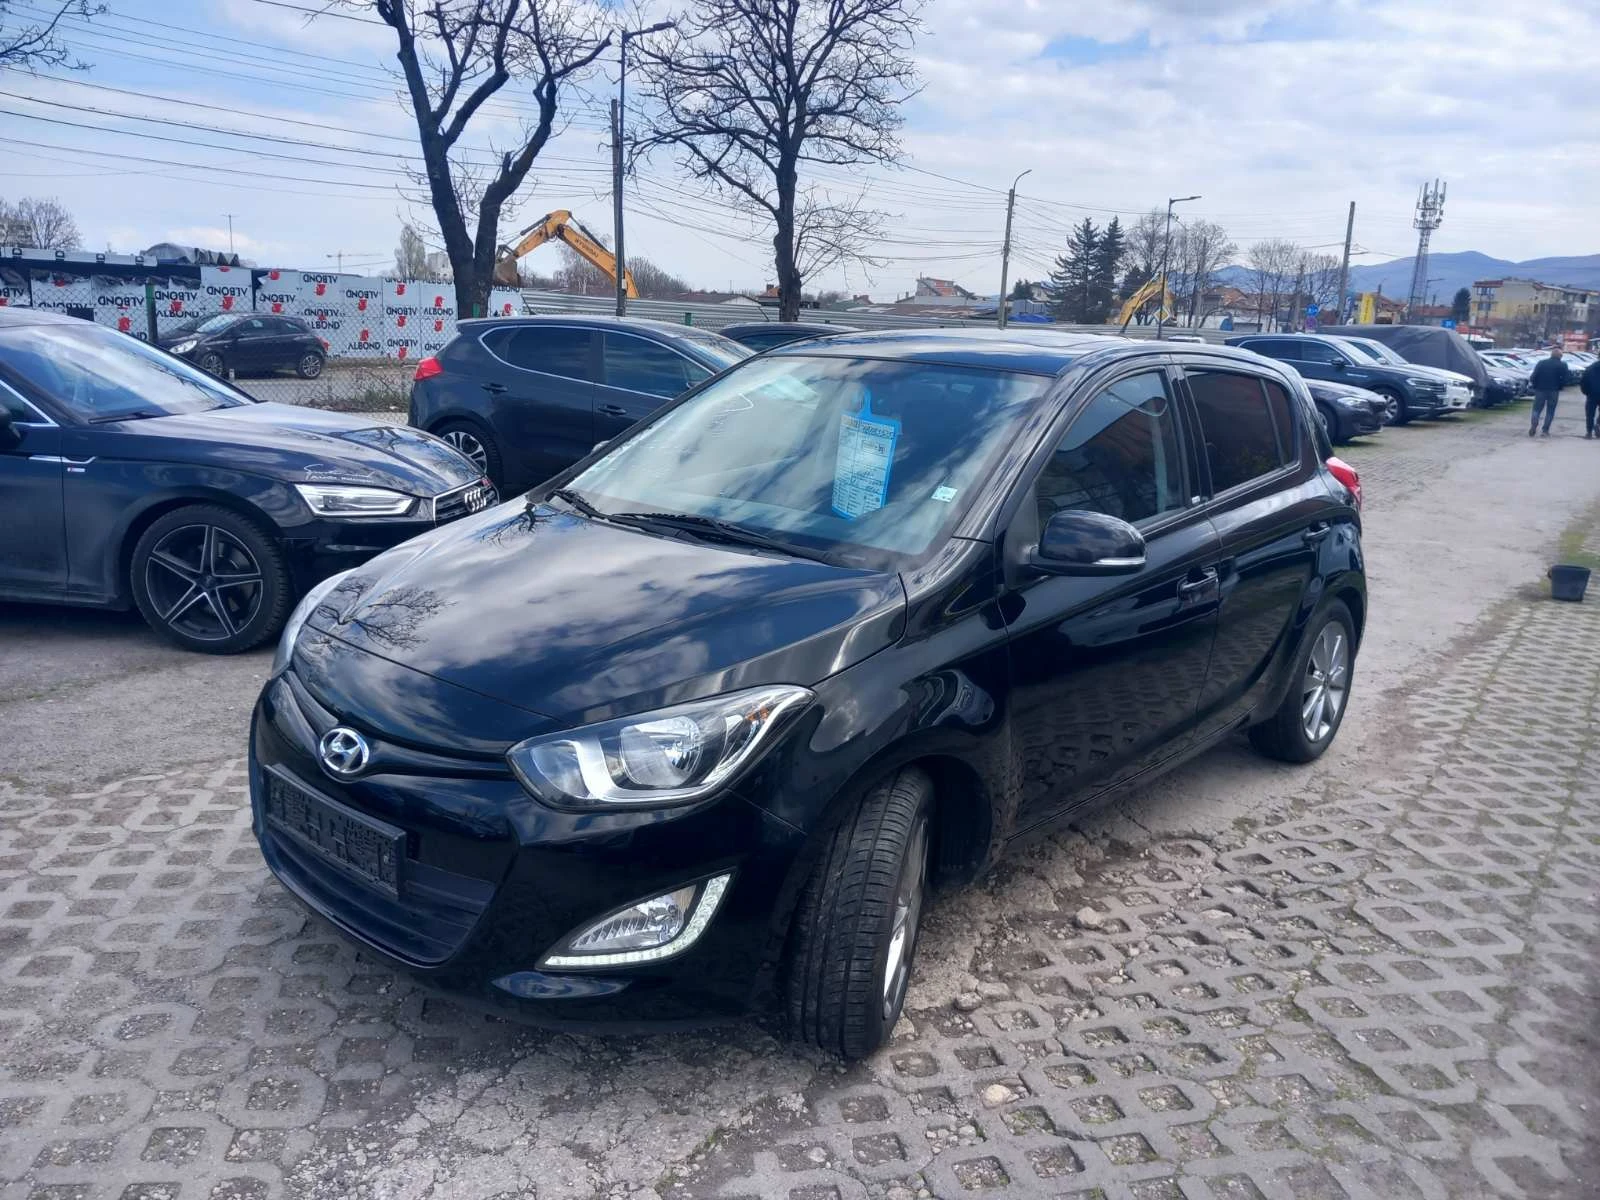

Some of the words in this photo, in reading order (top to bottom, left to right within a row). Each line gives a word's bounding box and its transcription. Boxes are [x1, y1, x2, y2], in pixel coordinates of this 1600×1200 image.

[303, 274, 338, 284] ALBOND
[0, 287, 25, 298] ALB
[154, 290, 198, 302] ALBOND
[206, 286, 248, 297] ALBOND
[346, 289, 379, 299] ALBOND
[98, 295, 145, 307] ALBOND
[259, 293, 296, 303] ALBOND
[304, 308, 340, 317] ALBOND
[386, 307, 417, 316] ALBOND
[423, 308, 454, 316] ALBOND
[307, 320, 340, 330] LBOND
[348, 341, 381, 350] ALBOND
[387, 338, 418, 347] ALBOND
